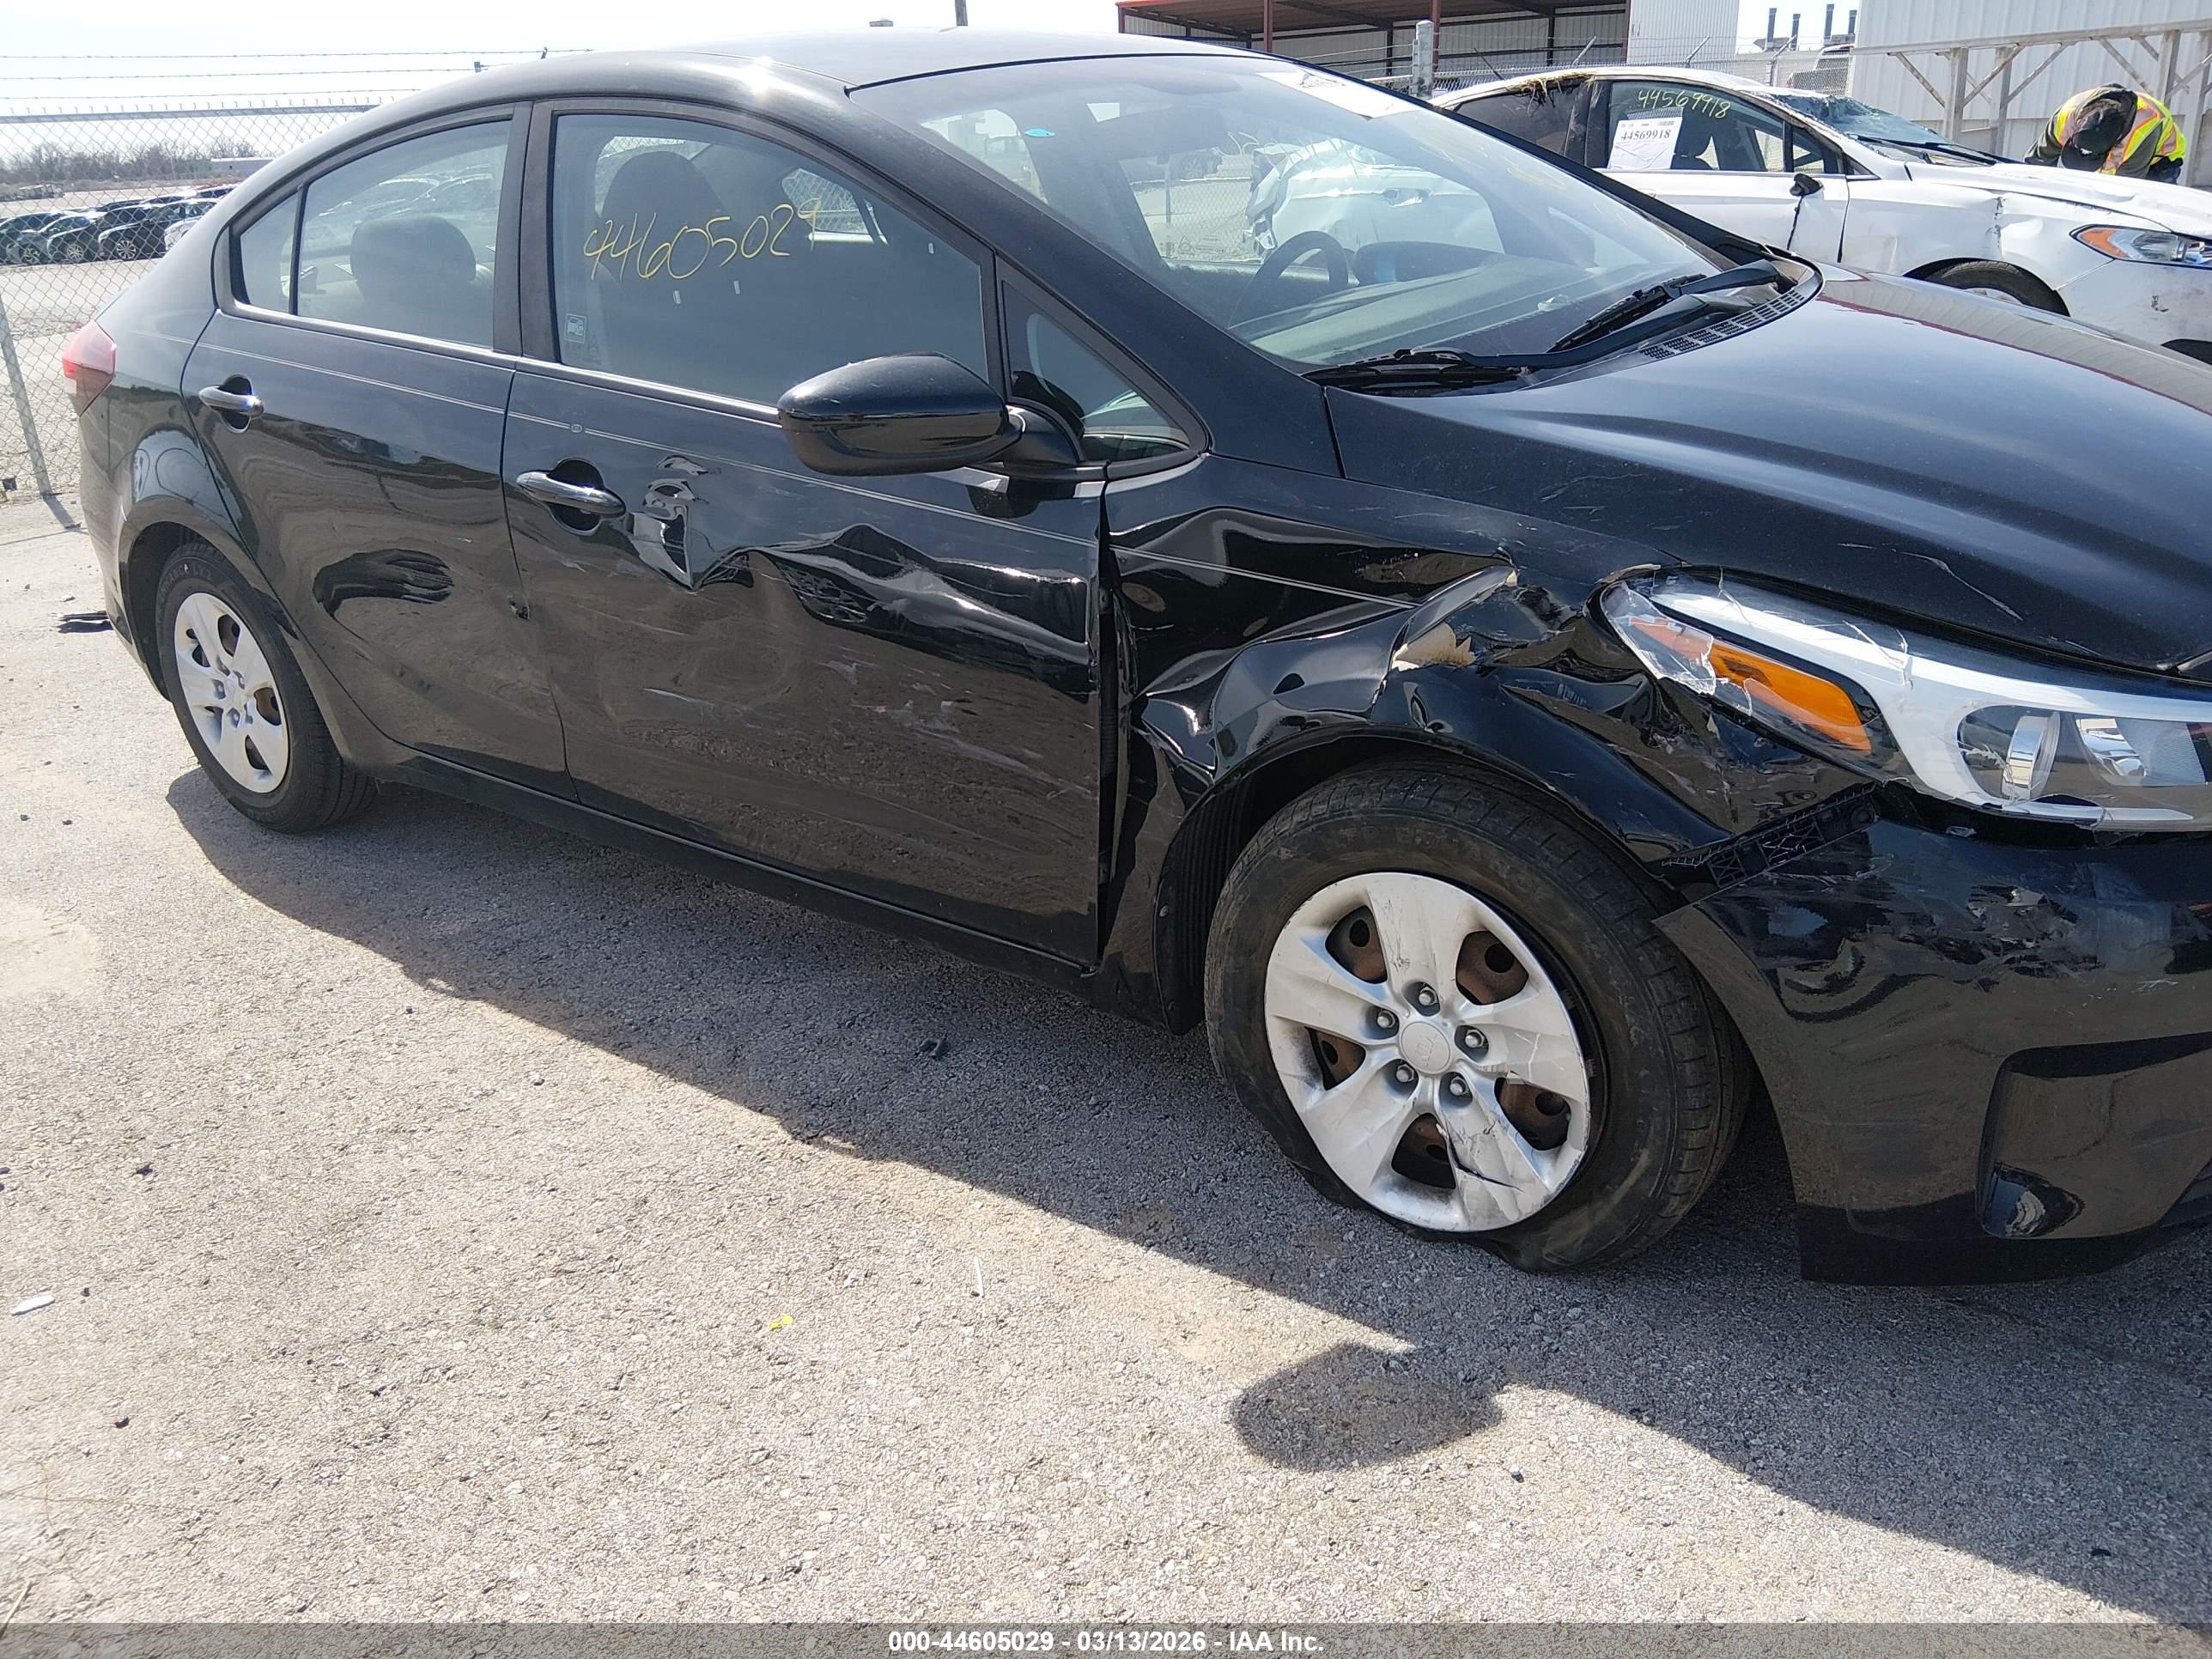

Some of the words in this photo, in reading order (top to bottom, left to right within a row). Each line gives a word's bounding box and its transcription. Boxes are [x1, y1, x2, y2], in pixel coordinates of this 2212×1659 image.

[1638, 90, 1731, 118] 44569918
[1620, 129, 1671, 140] 44569918
[583, 198, 822, 281] 44605029
